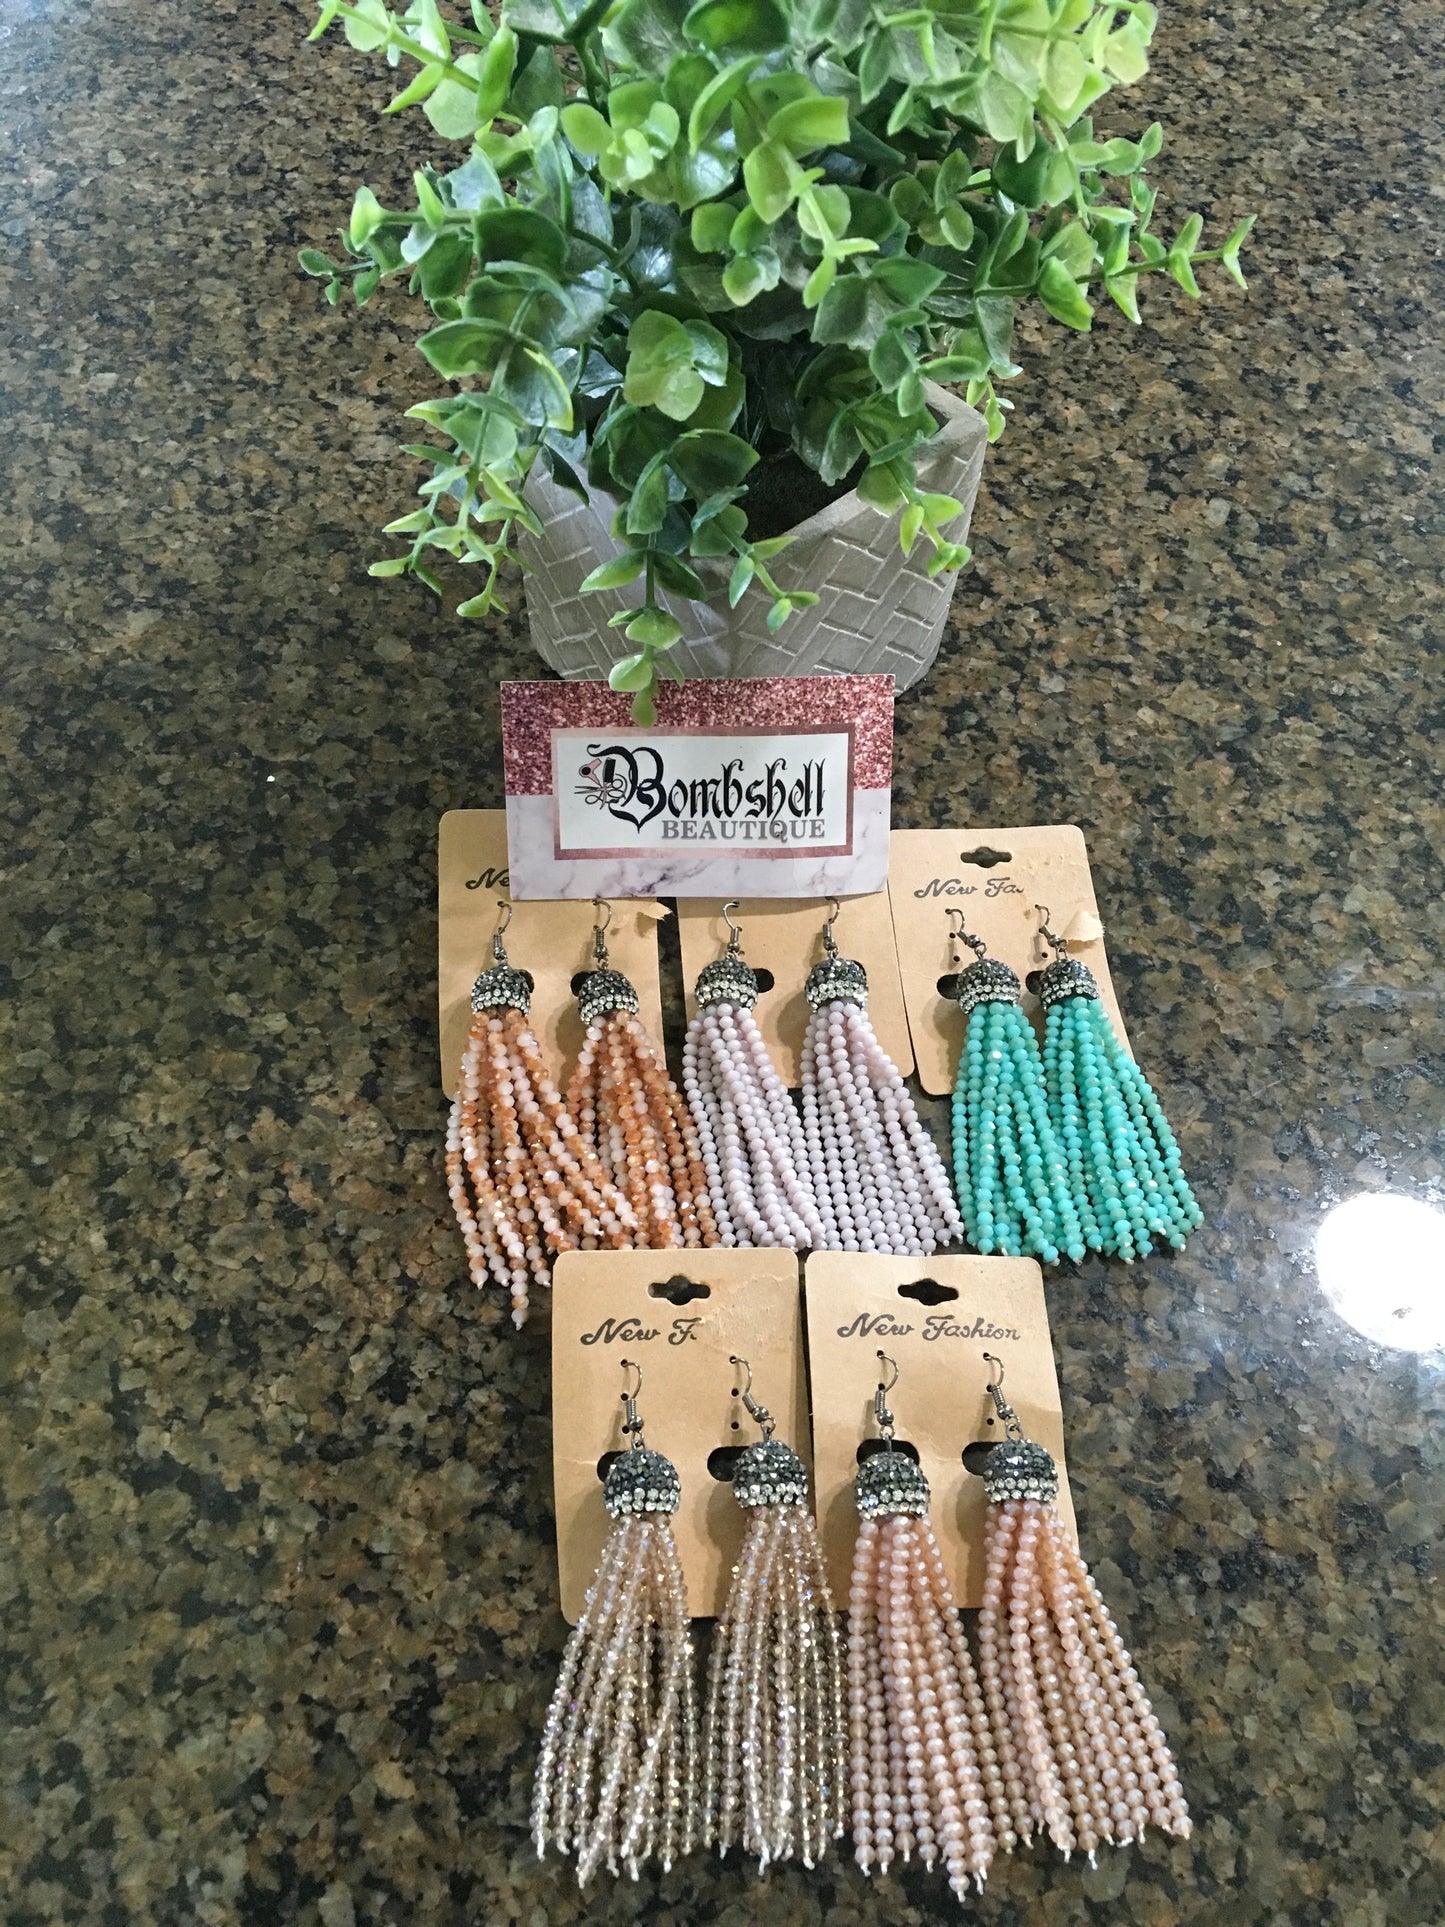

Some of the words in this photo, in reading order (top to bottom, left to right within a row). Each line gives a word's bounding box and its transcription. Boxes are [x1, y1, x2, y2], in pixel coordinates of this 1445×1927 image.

[587, 744, 825, 834] Bombshell
[662, 818, 826, 843] BEAUTIQUE
[465, 867, 511, 890] Ne
[913, 878, 978, 898] New
[580, 1318, 661, 1345] New
[836, 1312, 915, 1338] New
[921, 1314, 1021, 1341] Fashion
